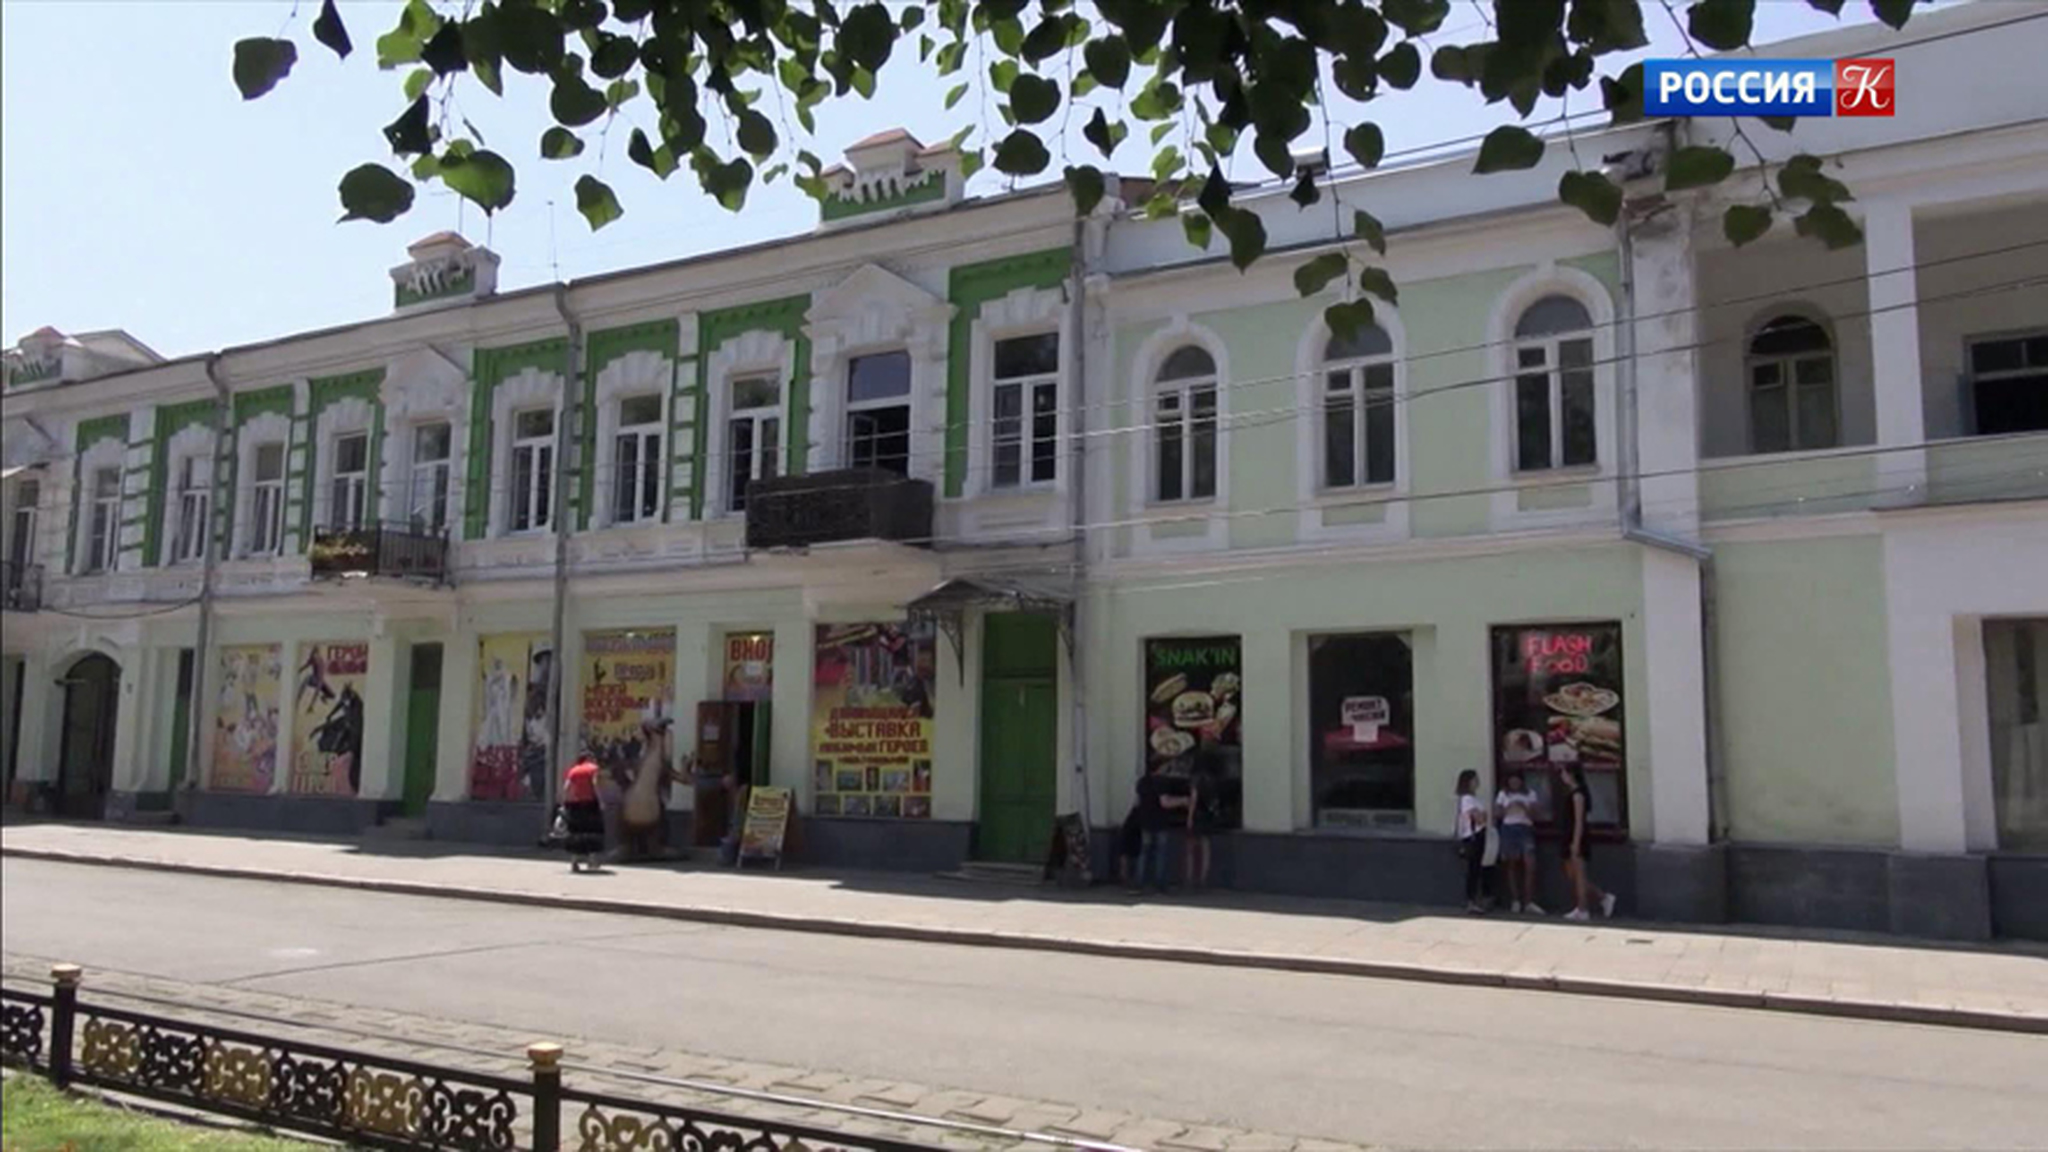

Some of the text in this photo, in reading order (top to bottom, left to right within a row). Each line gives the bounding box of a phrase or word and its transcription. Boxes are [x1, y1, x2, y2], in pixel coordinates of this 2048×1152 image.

[1526, 634, 1593, 655] FLASH
[1526, 654, 1588, 673] FOOD
[829, 720, 921, 739] ВЫСТАВКА
